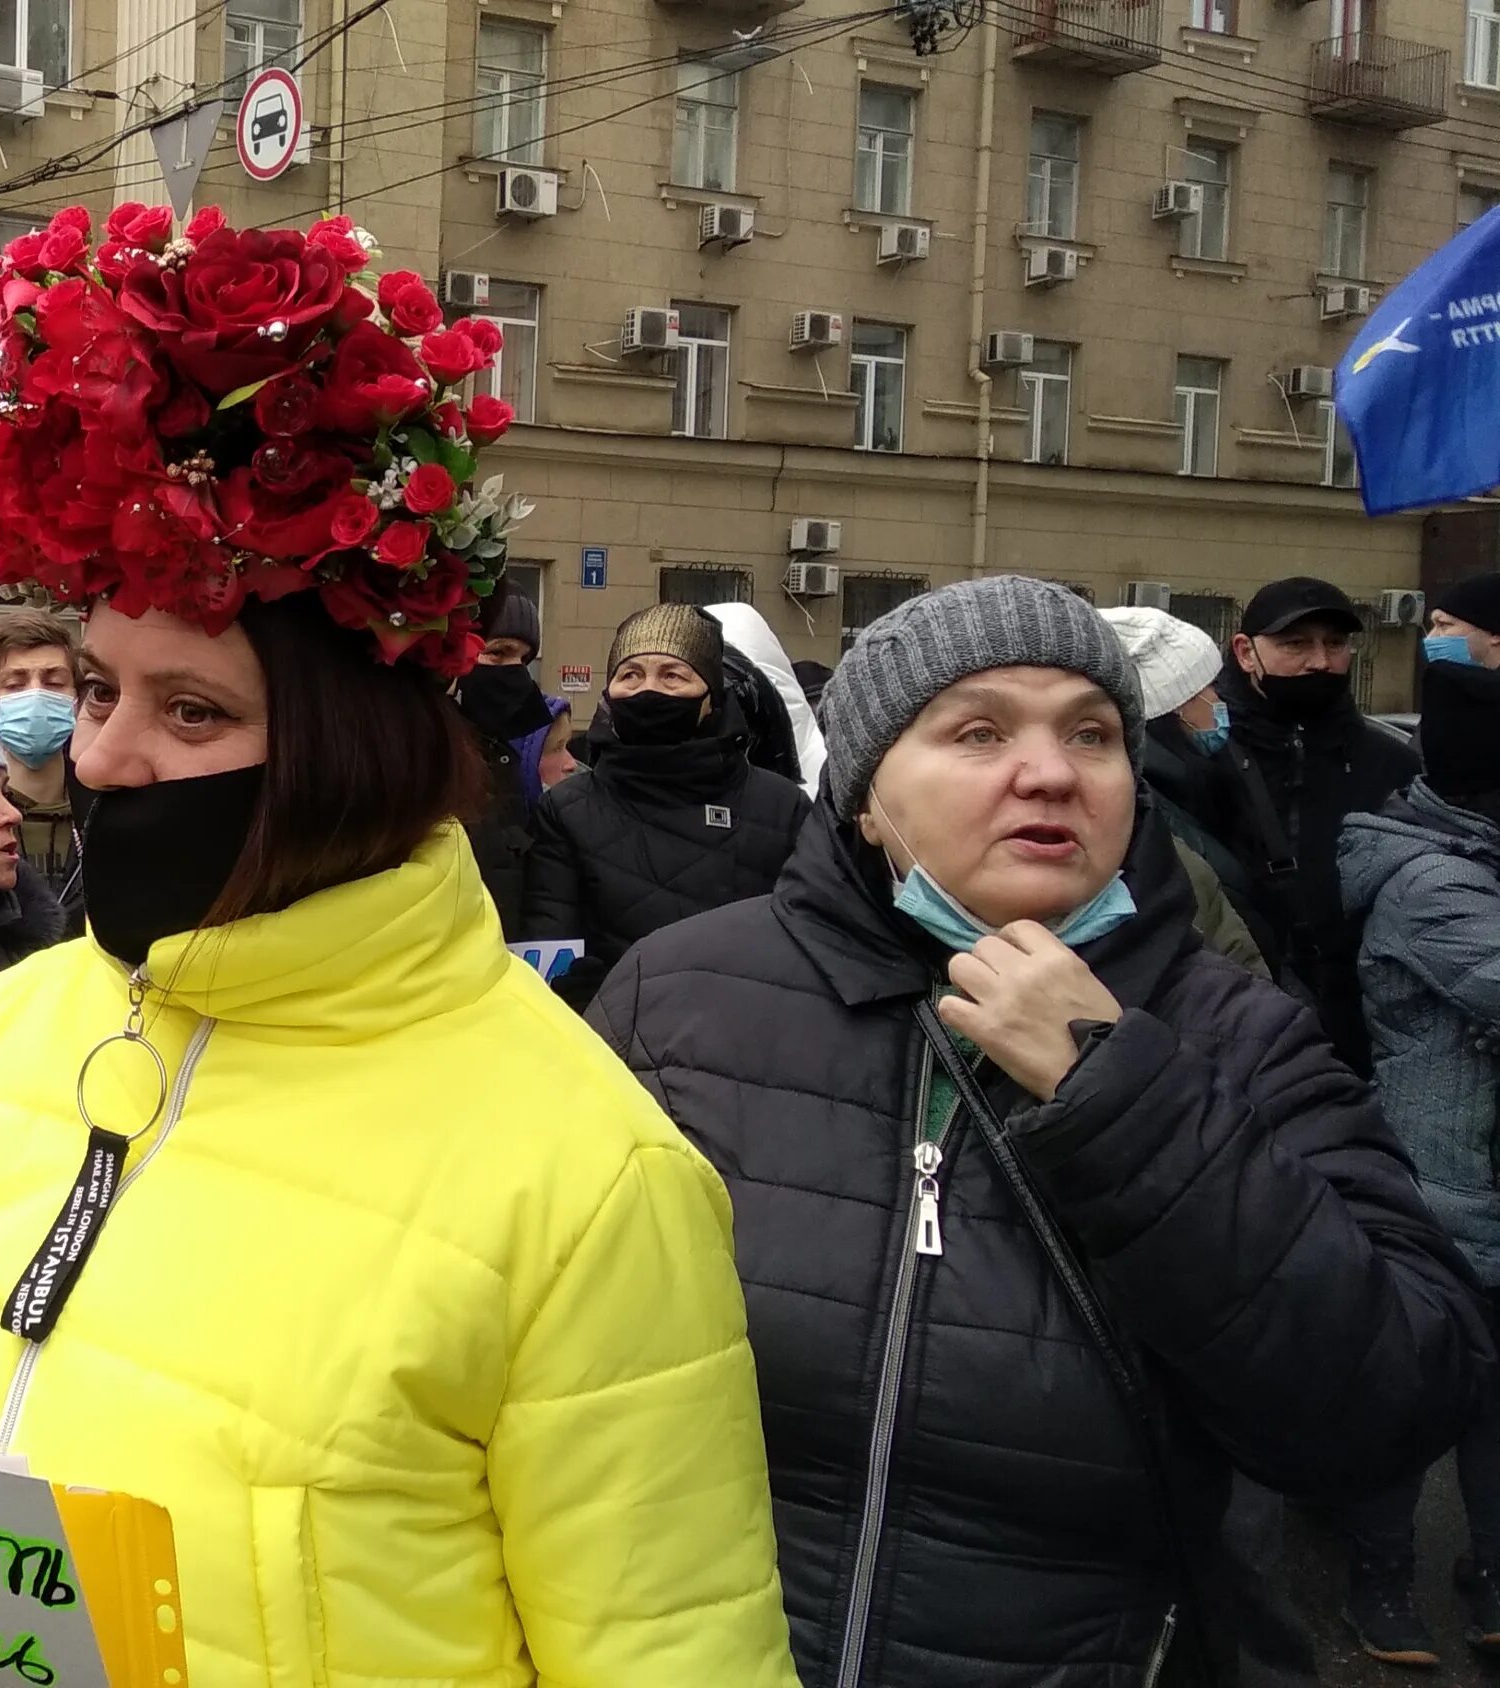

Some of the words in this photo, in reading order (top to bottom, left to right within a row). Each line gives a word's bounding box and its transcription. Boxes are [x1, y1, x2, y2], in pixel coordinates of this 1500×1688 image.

[67, 1186, 84, 1226] BERLIN
[66, 1209, 93, 1262] LONDON
[25, 1227, 72, 1330] ISTANBUL
